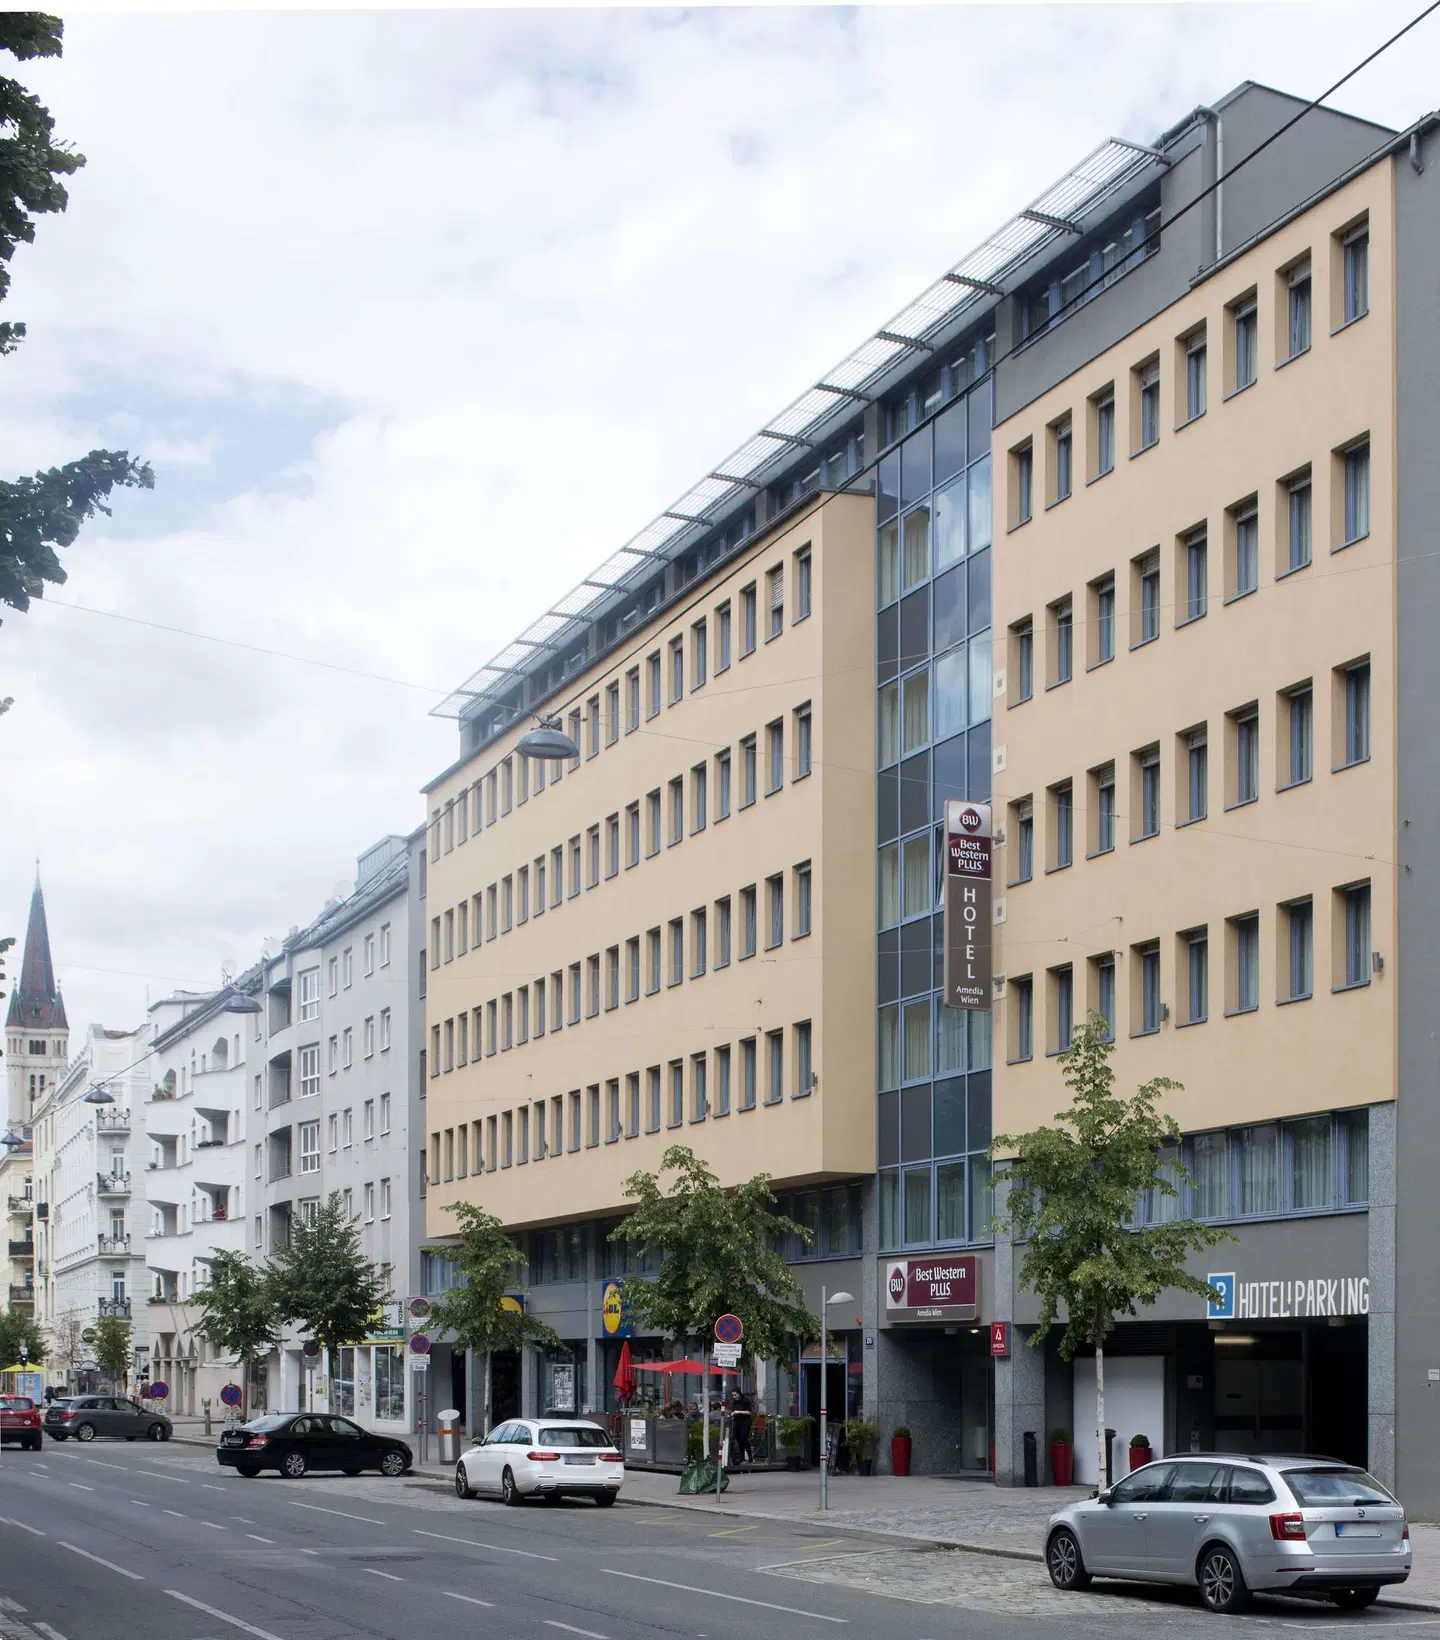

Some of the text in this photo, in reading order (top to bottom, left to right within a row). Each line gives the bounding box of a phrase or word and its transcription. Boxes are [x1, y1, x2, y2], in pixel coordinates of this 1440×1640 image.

[962, 814, 979, 826] BW
[960, 839, 981, 851] Best
[951, 847, 989, 861] Western
[957, 858, 983, 871] PLUS
[963, 887, 976, 979] HOTEL
[956, 985, 984, 996] Amedia
[960, 995, 979, 1004] Wien
[916, 1267, 965, 1281] Best Western
[890, 1278, 904, 1291] BW
[930, 1282, 951, 1297] PLUS
[1239, 1281, 1290, 1318] HOTEL
[1294, 1277, 1370, 1317] PARKING
[916, 1308, 942, 1317] Amedia Wien
